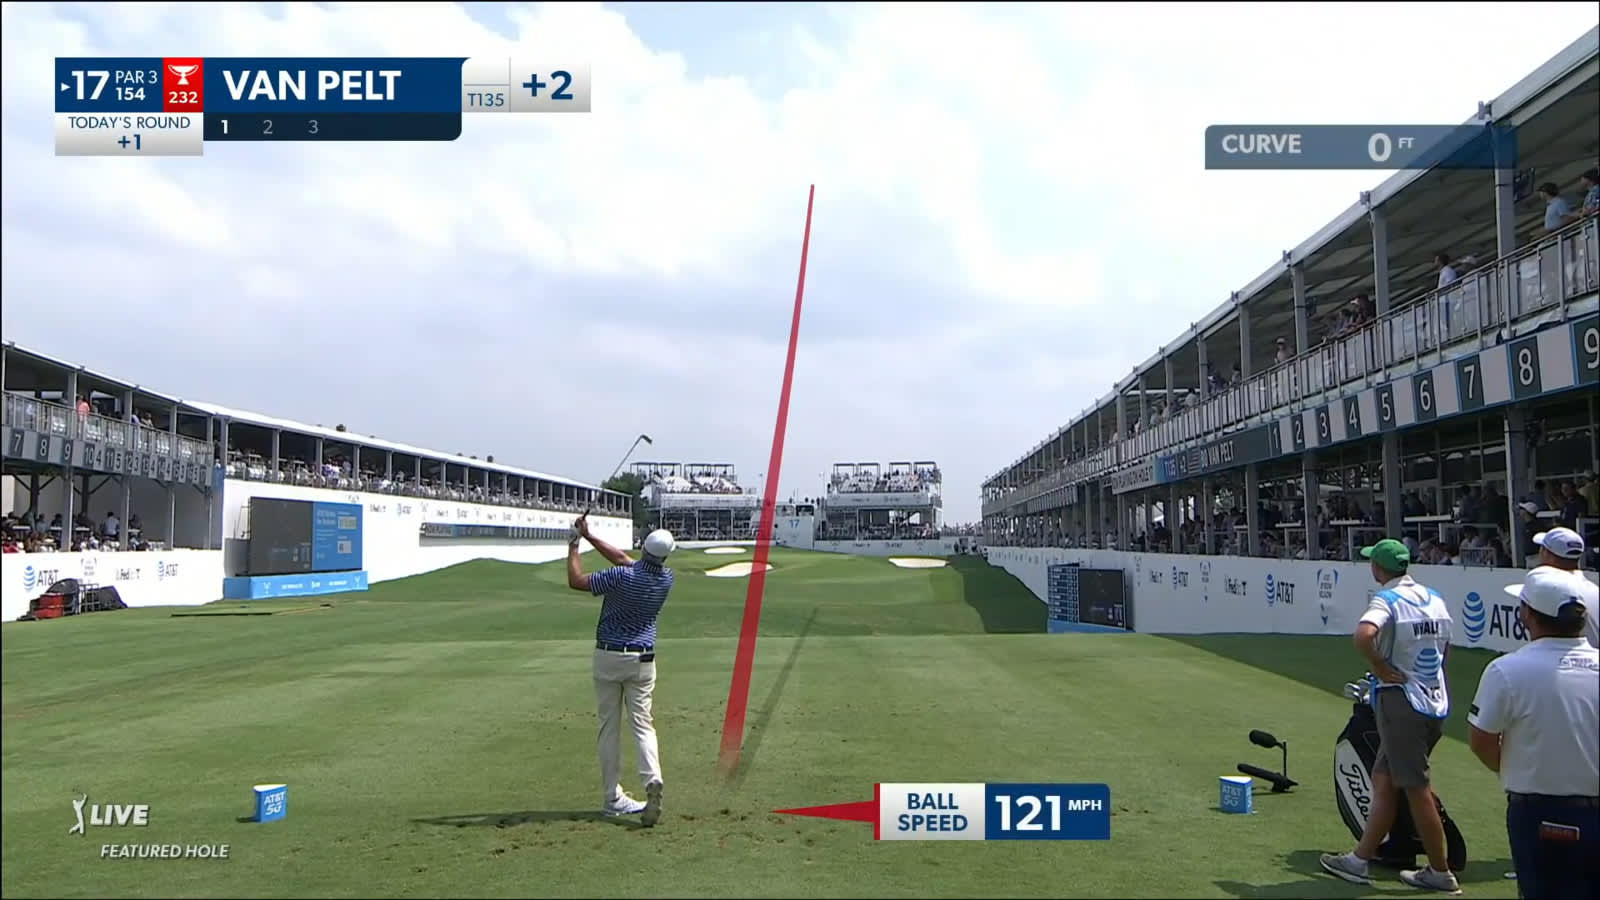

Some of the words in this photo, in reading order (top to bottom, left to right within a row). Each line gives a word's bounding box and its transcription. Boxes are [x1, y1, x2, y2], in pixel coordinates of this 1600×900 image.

[1320, 412, 1329, 439] 3
[1349, 403, 1358, 430] 4
[1381, 392, 1392, 422] 5
[1420, 379, 1432, 411] 6
[1464, 364, 1476, 399] 7
[1518, 348, 1534, 386] 8
[40, 439, 48, 457] 8
[37, 569, 59, 587] AT&T
[1276, 580, 1295, 605] AT&T
[1489, 603, 1529, 642] AT&
[264, 791, 286, 805] AT&T
[265, 802, 282, 815] 5G
